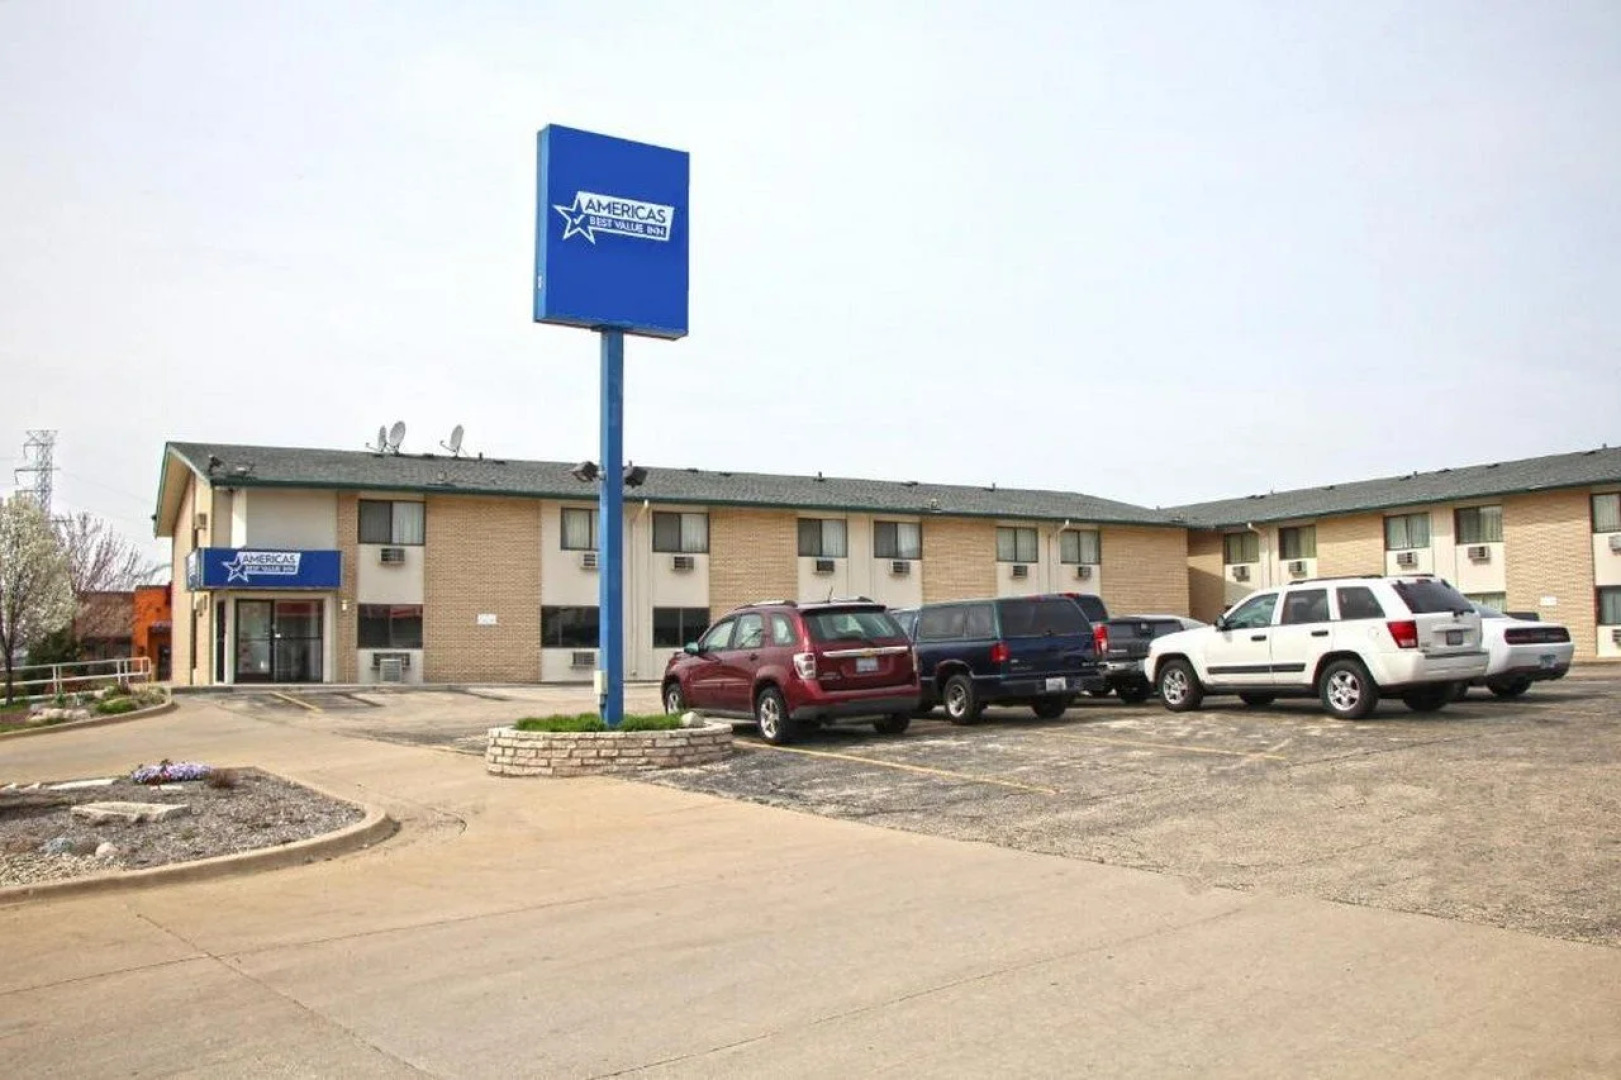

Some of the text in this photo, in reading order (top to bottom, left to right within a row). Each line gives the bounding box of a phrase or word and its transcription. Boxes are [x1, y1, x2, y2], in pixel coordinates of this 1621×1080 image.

[585, 199, 666, 224] AMERICAS
[589, 216, 665, 236] BEST VALUE INN
[242, 555, 295, 563] AMERICAS
